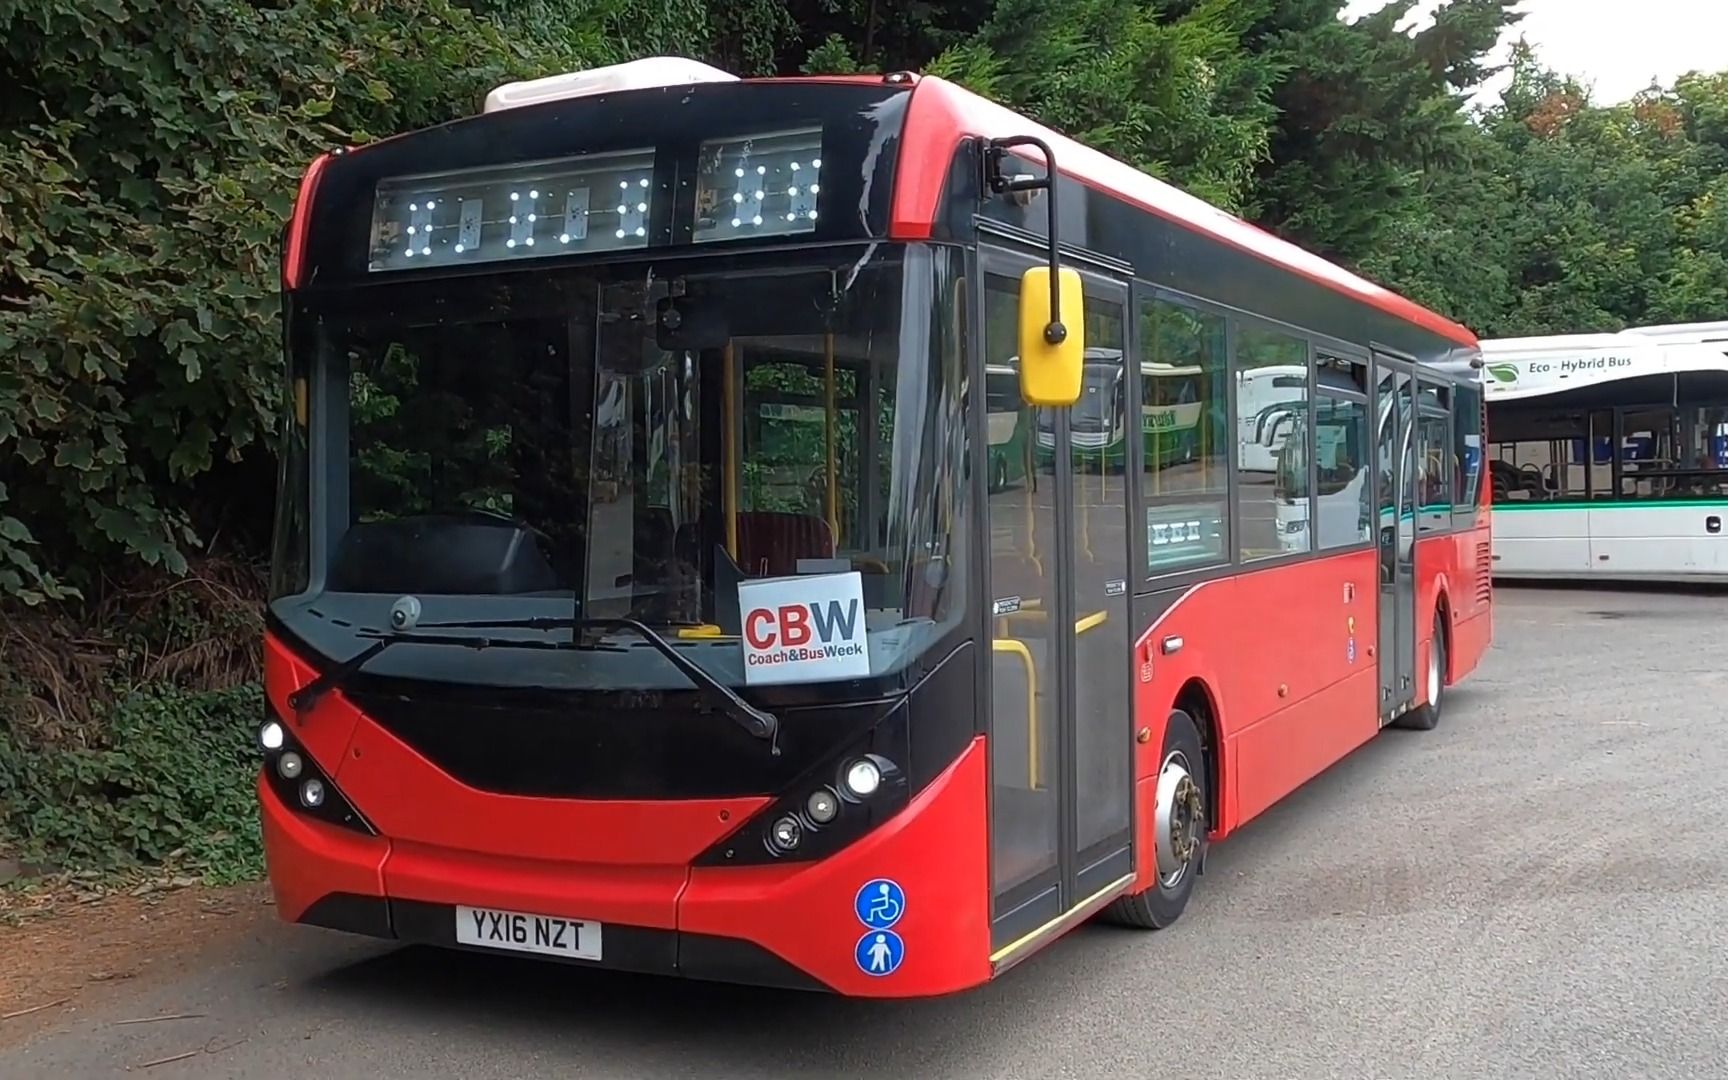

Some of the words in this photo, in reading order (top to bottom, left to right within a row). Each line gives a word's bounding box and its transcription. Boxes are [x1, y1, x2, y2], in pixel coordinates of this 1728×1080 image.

[1529, 362, 1550, 373] Eco
[1561, 358, 1605, 375] Hybrid
[1609, 356, 1632, 367] Bus
[745, 599, 858, 650] CBW
[748, 643, 863, 666] Coach&BusWeek
[472, 910, 527, 944] YX16
[535, 917, 584, 950] NZT
